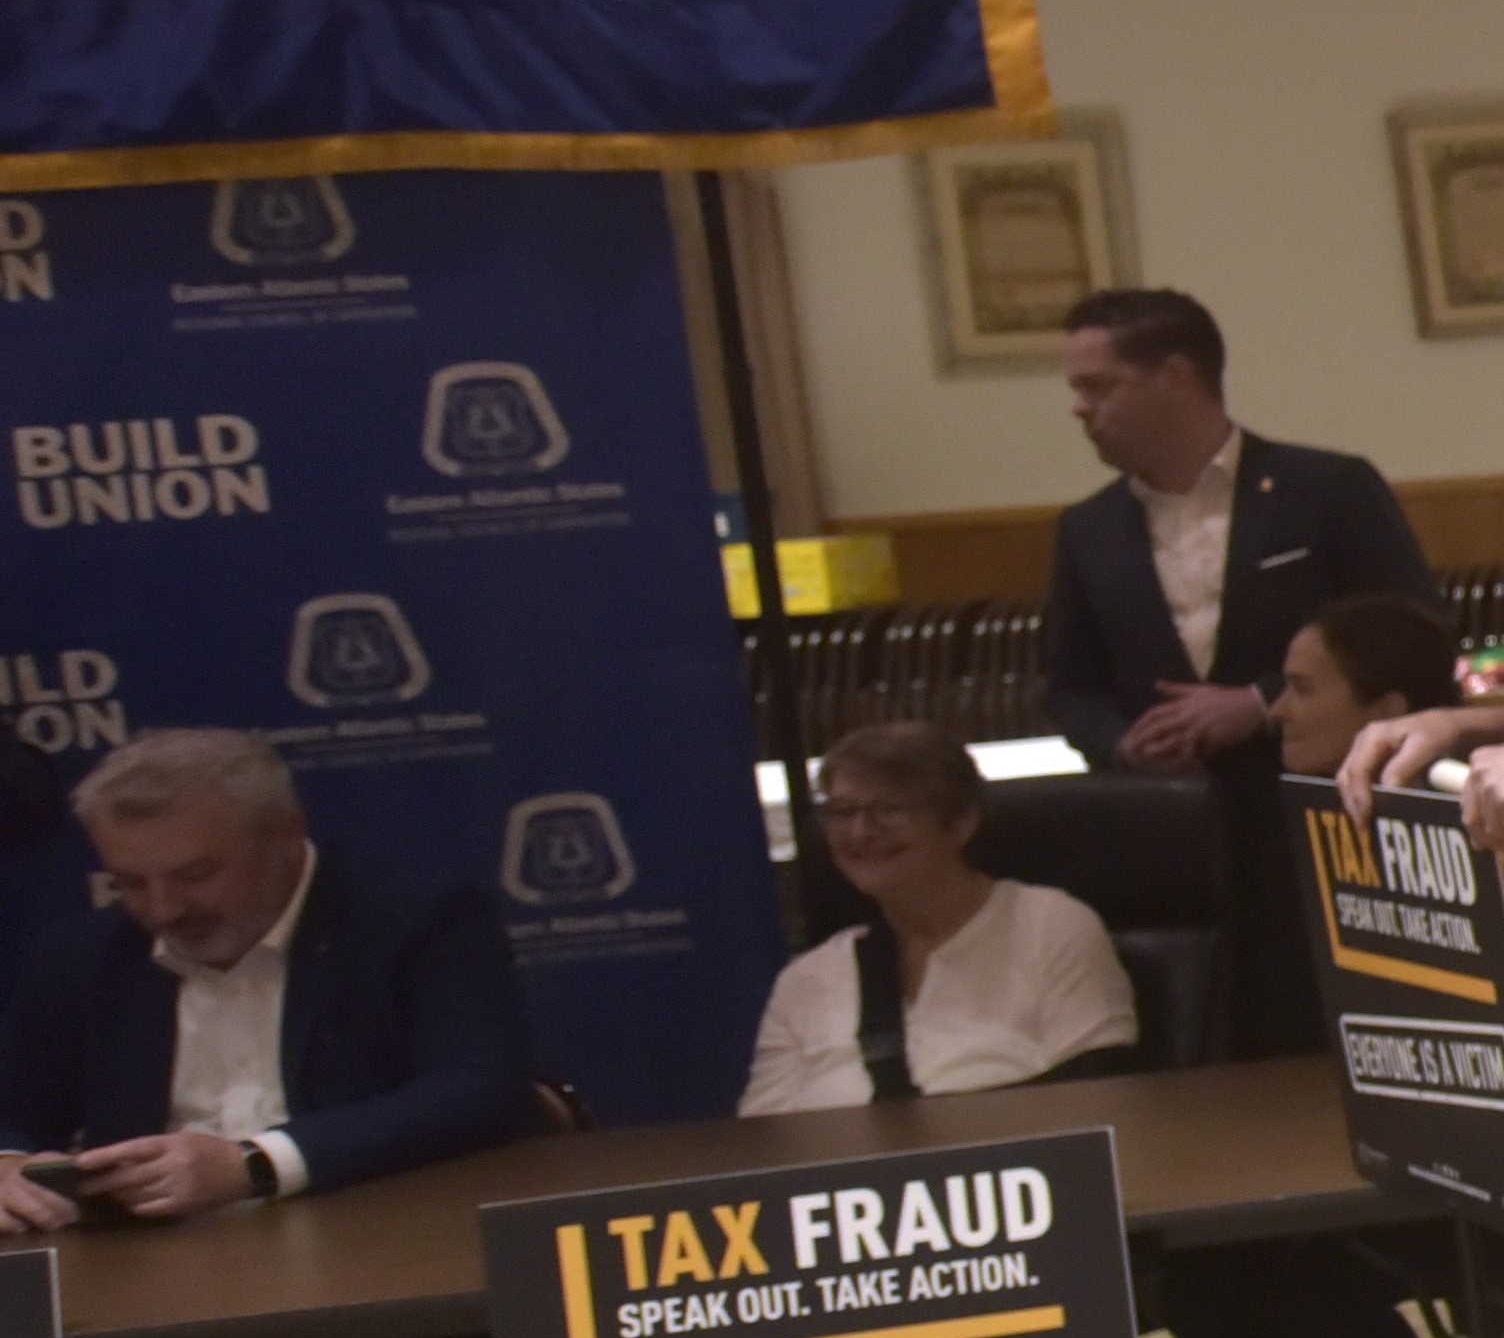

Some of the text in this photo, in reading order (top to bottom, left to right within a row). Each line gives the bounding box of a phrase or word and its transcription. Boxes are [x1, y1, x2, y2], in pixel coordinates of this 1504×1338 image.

[12, 413, 259, 479] BUILD
[17, 465, 271, 529] UNION
[1376, 816, 1477, 907] FRAUD
[606, 1165, 1054, 1291] TAX FRAUD
[736, 1281, 811, 1324] OUT.
[816, 1268, 902, 1313] TAKE
[909, 1251, 1040, 1302] ACTION.
